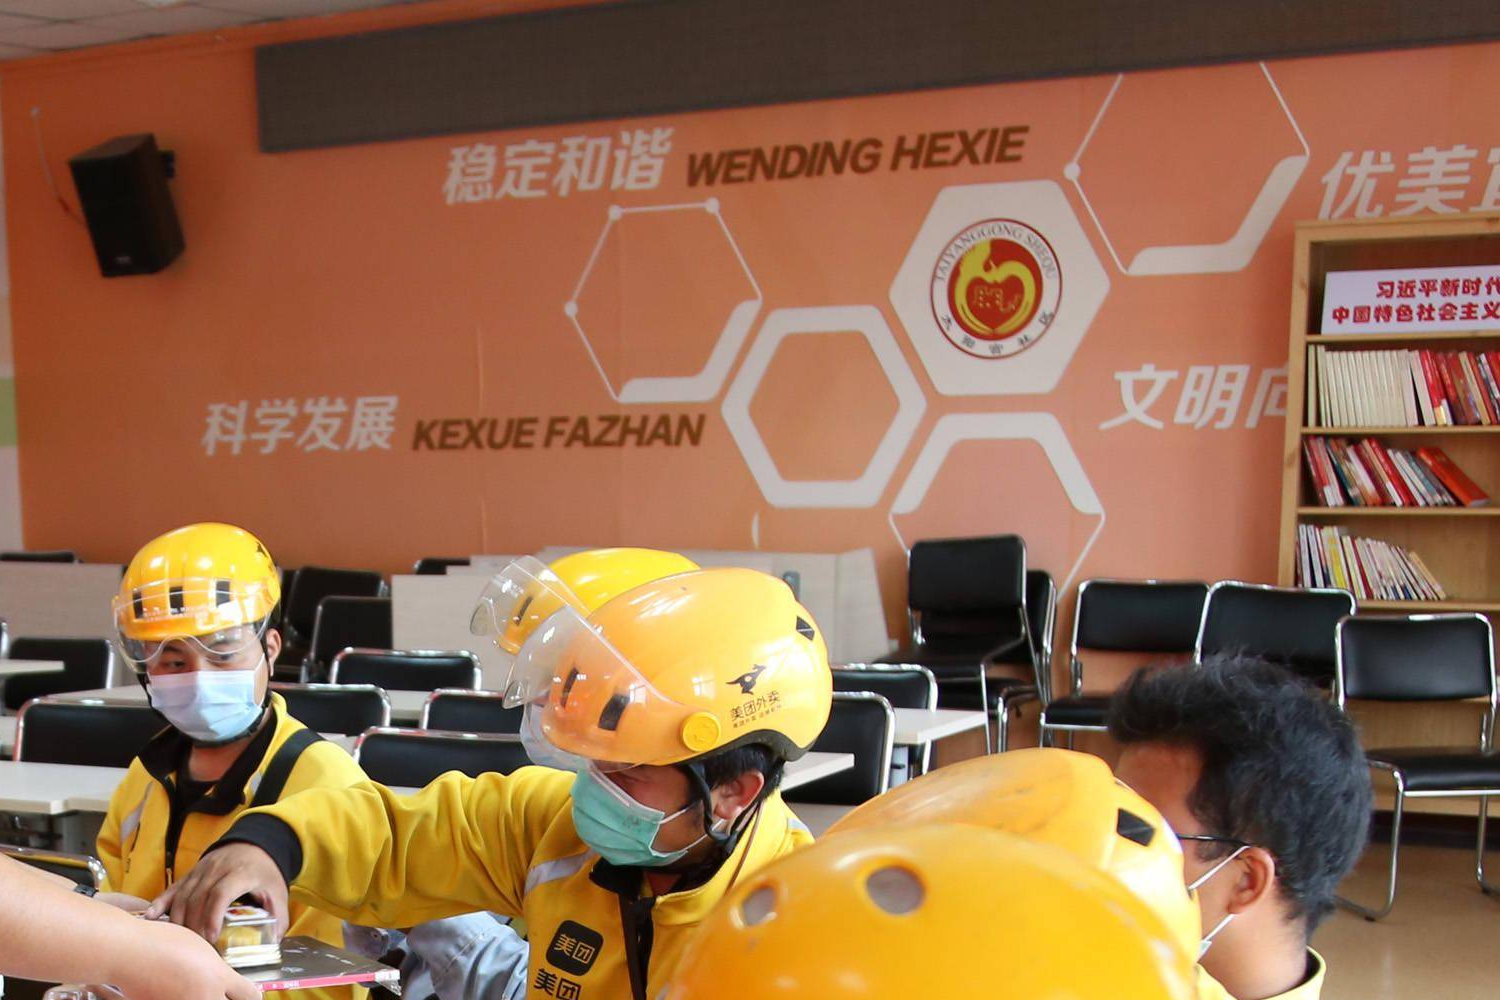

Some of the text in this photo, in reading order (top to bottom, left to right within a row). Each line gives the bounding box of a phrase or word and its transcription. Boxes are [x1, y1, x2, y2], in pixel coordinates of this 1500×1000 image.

[441, 127, 674, 205] 稳定和谐
[687, 125, 1030, 187] WENDING HEXIE
[1332, 300, 1500, 325] 中国特色社会主义
[202, 394, 398, 456] 科学发展
[412, 413, 705, 451] KEXUE FAZHAN
[553, 933, 596, 965] 美团
